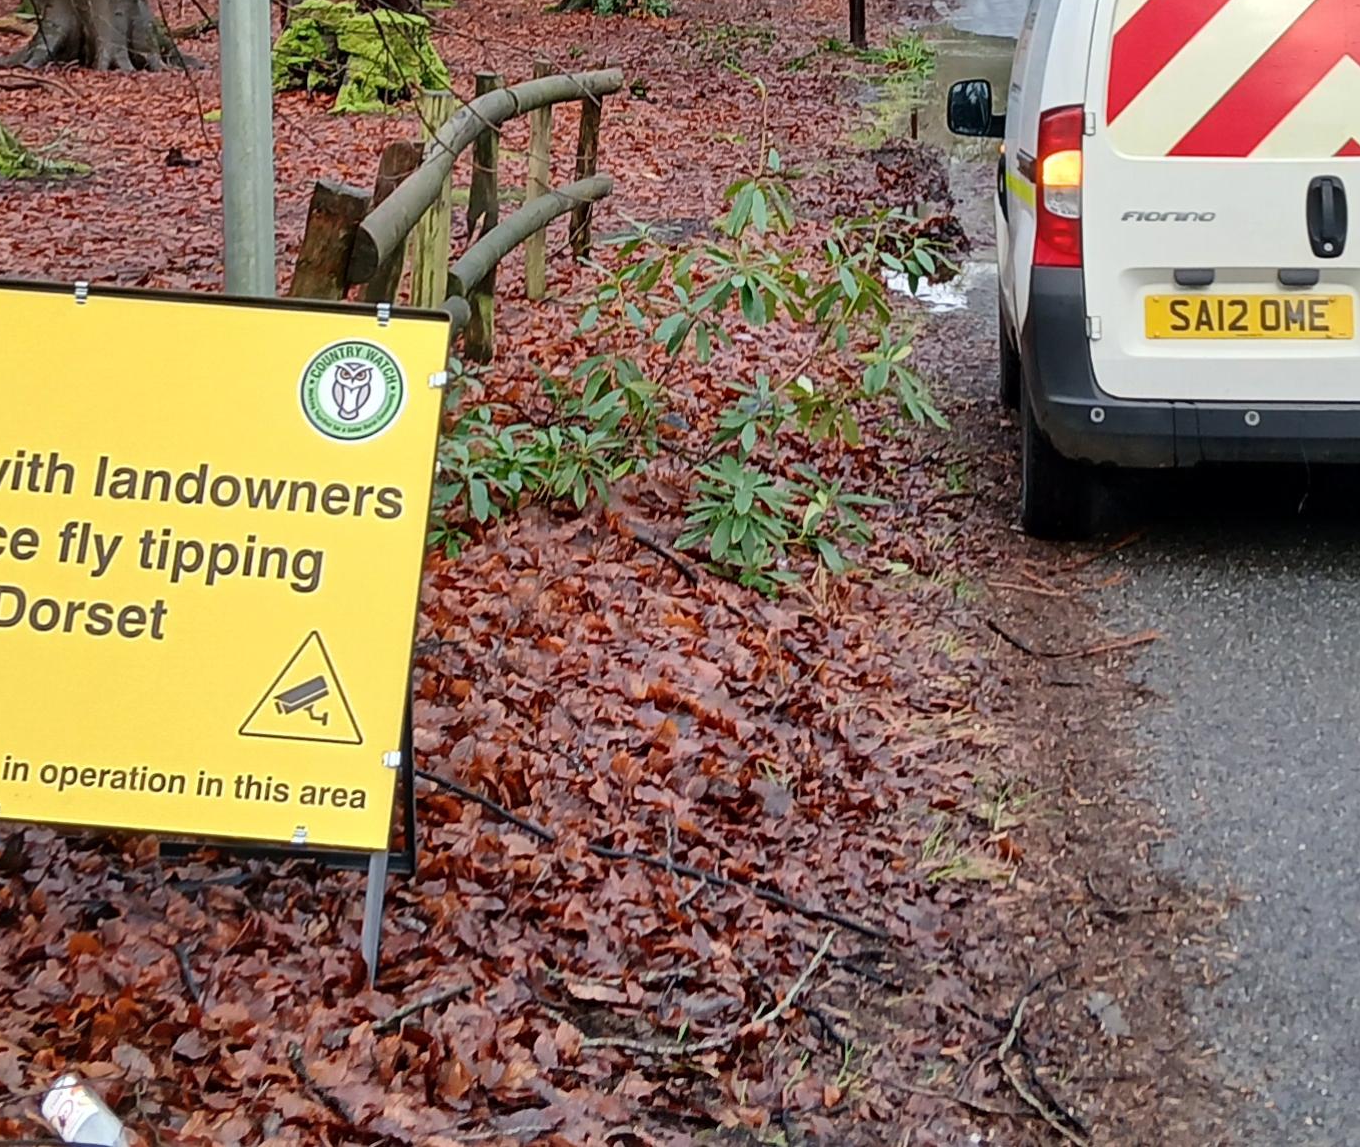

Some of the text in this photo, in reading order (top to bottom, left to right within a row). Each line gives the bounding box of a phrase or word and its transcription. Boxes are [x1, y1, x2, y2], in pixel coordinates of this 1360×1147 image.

[1169, 299, 1330, 332] SA12 OME
[310, 346, 397, 384] COUNTRY WATCH
[93, 455, 403, 520] landowners
[58, 521, 124, 578] fly
[138, 528, 324, 594] tipping
[2, 755, 30, 782] in
[39, 764, 186, 795] operation
[196, 770, 223, 798] in
[234, 774, 290, 803] this
[299, 785, 367, 809] area
